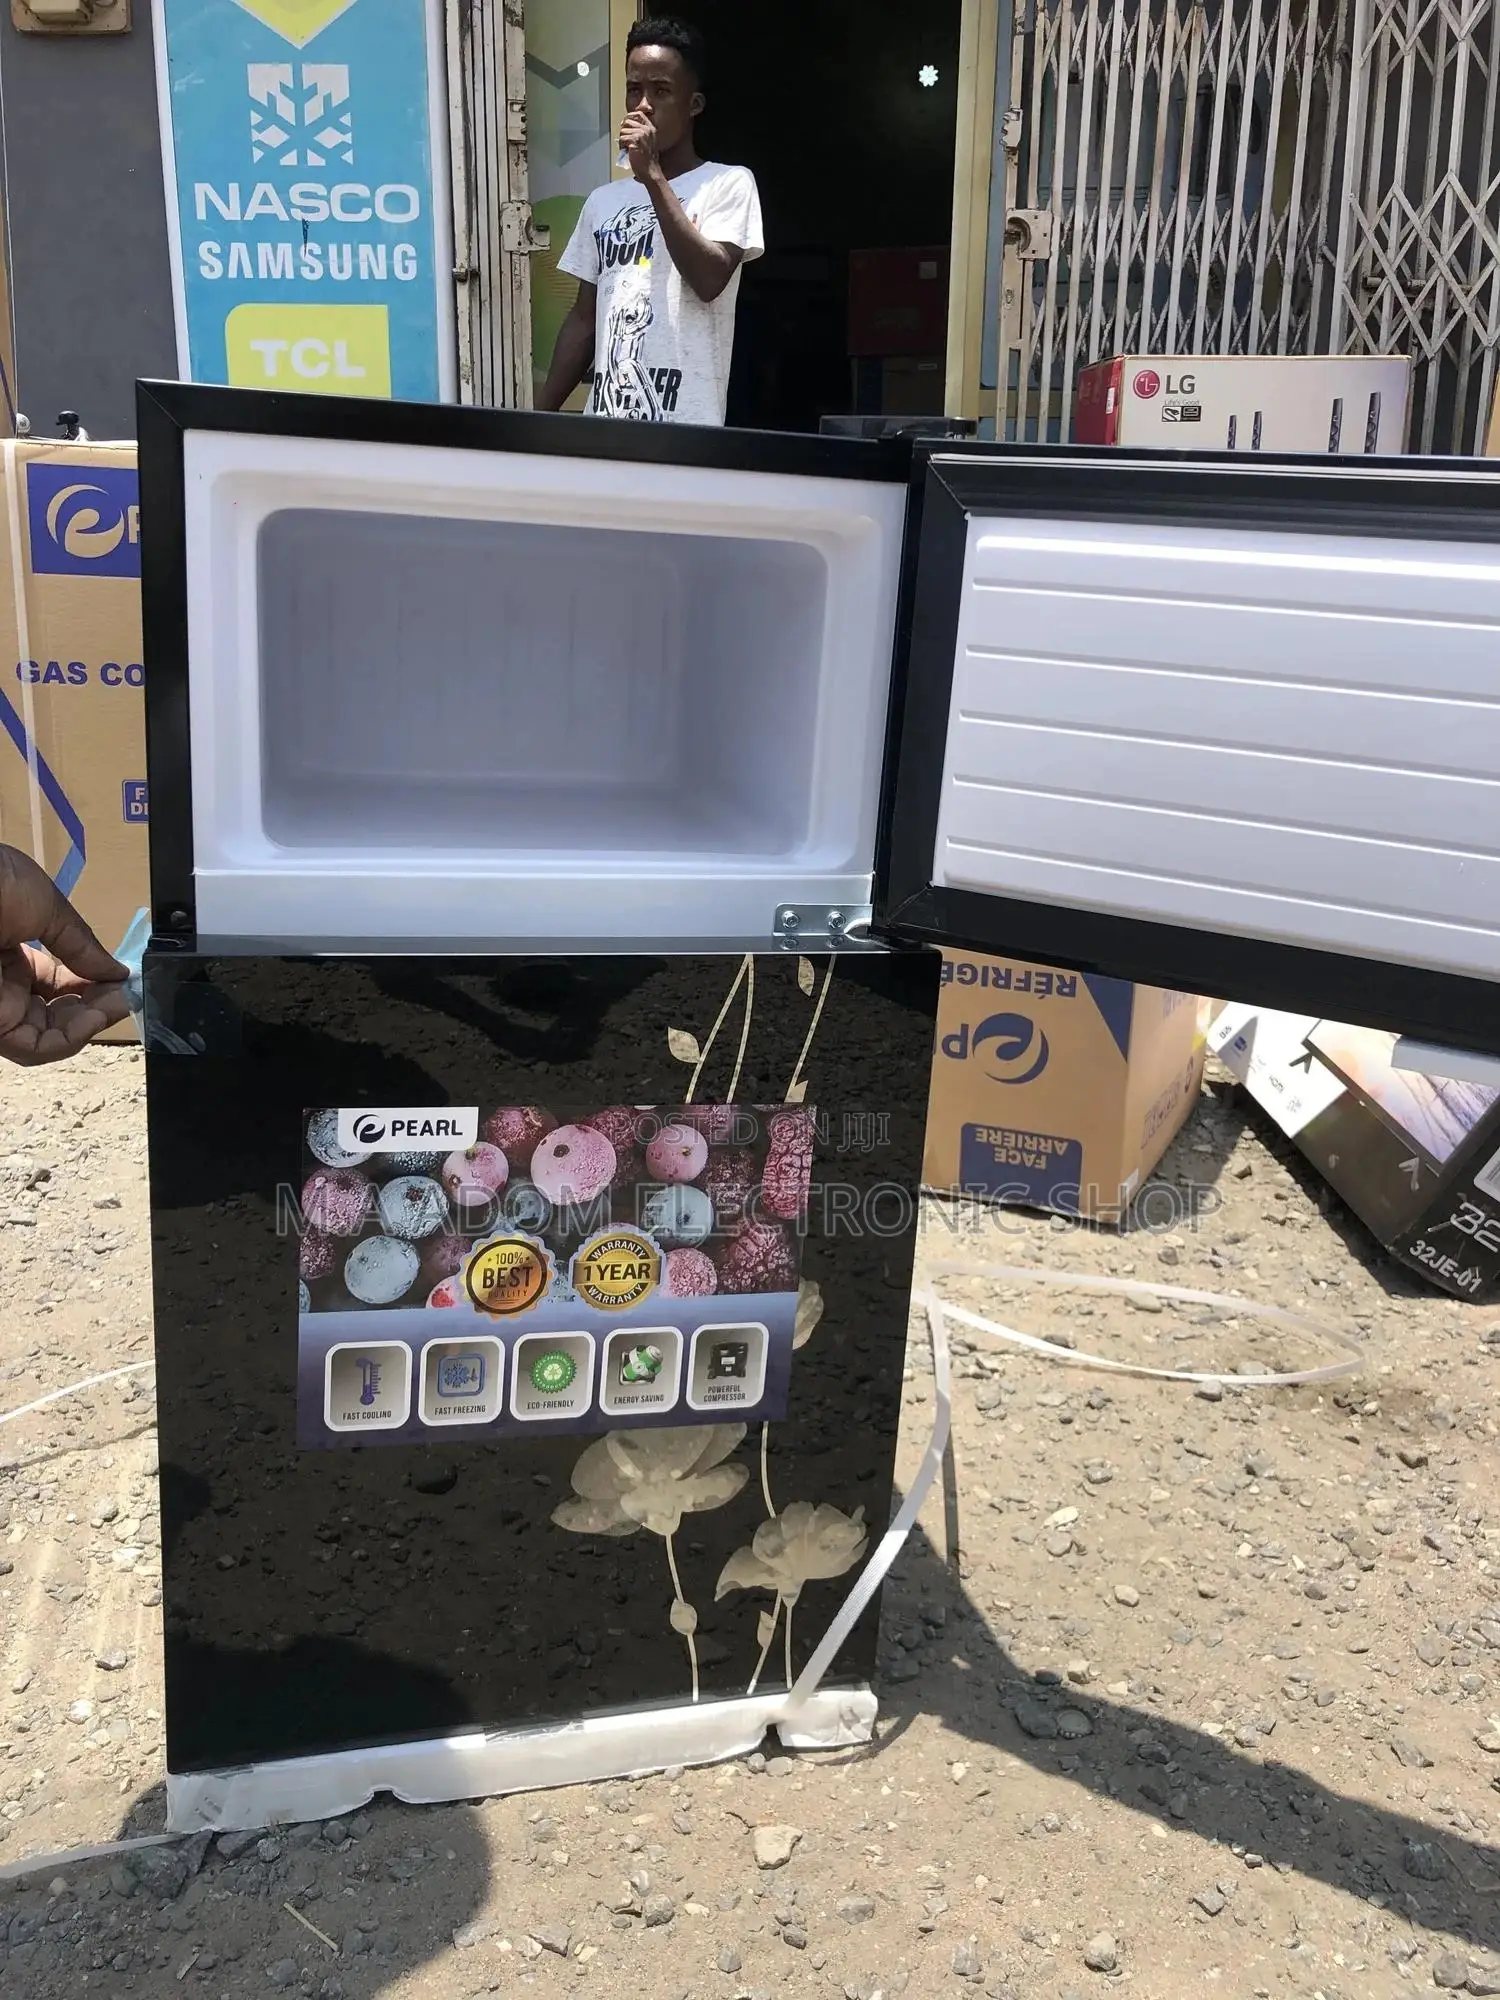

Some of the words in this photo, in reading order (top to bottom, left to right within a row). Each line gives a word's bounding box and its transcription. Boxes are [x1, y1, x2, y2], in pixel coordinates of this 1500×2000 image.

[194, 182, 420, 223] NASCO
[198, 240, 418, 281] SAMSUNG
[249, 337, 367, 380] TCL
[1165, 374, 1196, 395] LG
[16, 660, 88, 685] GAS
[391, 1119, 463, 1137] PEARL
[994, 1148, 1048, 1170] FACE
[496, 1252, 523, 1265] 100%
[591, 1240, 646, 1260] WARRANTY
[583, 1265, 592, 1281] 1
[599, 1263, 651, 1281] YEAR
[1409, 1239, 1482, 1293] 32JE-01
[482, 1266, 533, 1288] BEST
[587, 1284, 644, 1304] WARRANTY
[613, 1396, 639, 1405] ENERGY
[640, 1394, 665, 1403] SAVING
[703, 1392, 746, 1402] COMPRESSOR
[707, 1385, 741, 1394] POWERFUL
[434, 1406, 451, 1415] FAST
[453, 1405, 486, 1414] FREEZING
[526, 1399, 575, 1410] ECO-FRIENDLY
[342, 1412, 360, 1421] FAST
[362, 1410, 392, 1420] COOLING
